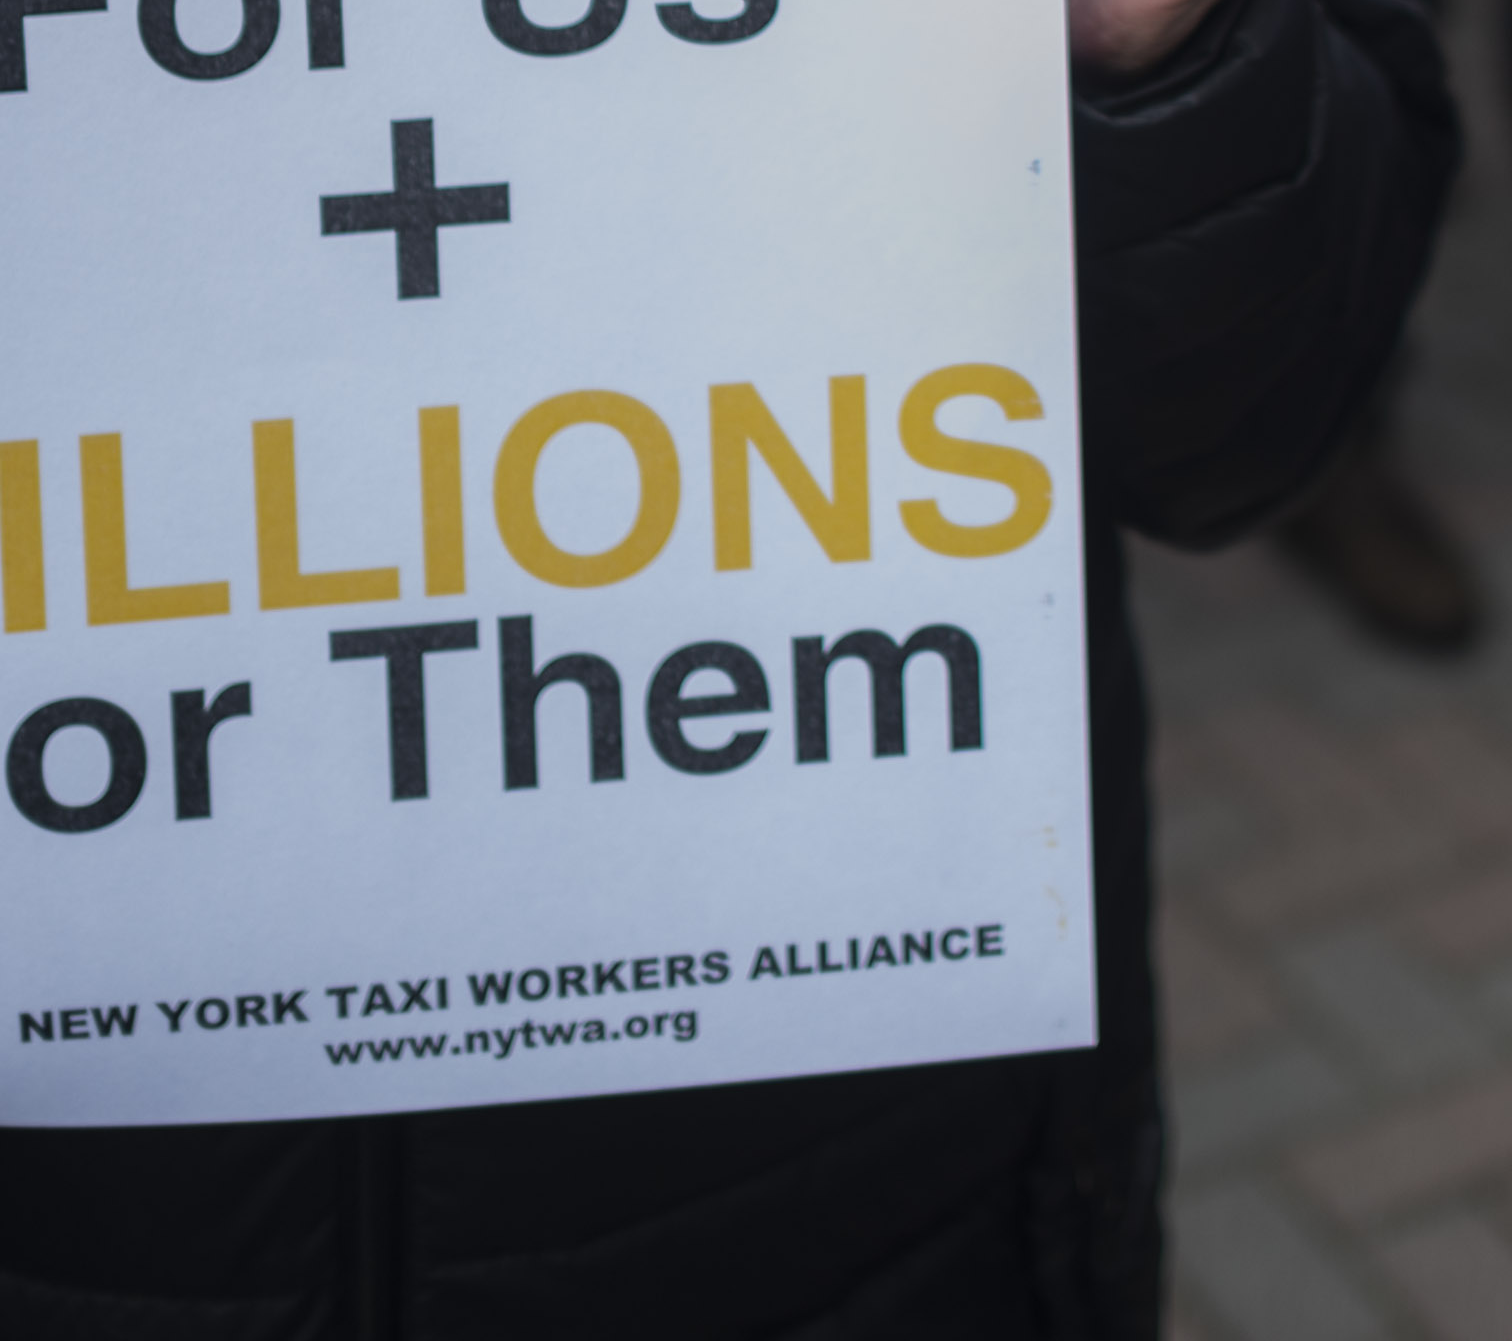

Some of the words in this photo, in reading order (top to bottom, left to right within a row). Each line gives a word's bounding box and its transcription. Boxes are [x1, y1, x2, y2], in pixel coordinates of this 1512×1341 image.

[328, 613, 986, 803] Them
[18, 1004, 140, 1045] NEW
[155, 989, 311, 1034] YORK
[324, 976, 451, 1020] TAXI
[467, 950, 732, 1007] WORKERS
[749, 923, 1006, 981] ALLIANCE
[322, 1009, 699, 1067] www.nytwa.org
